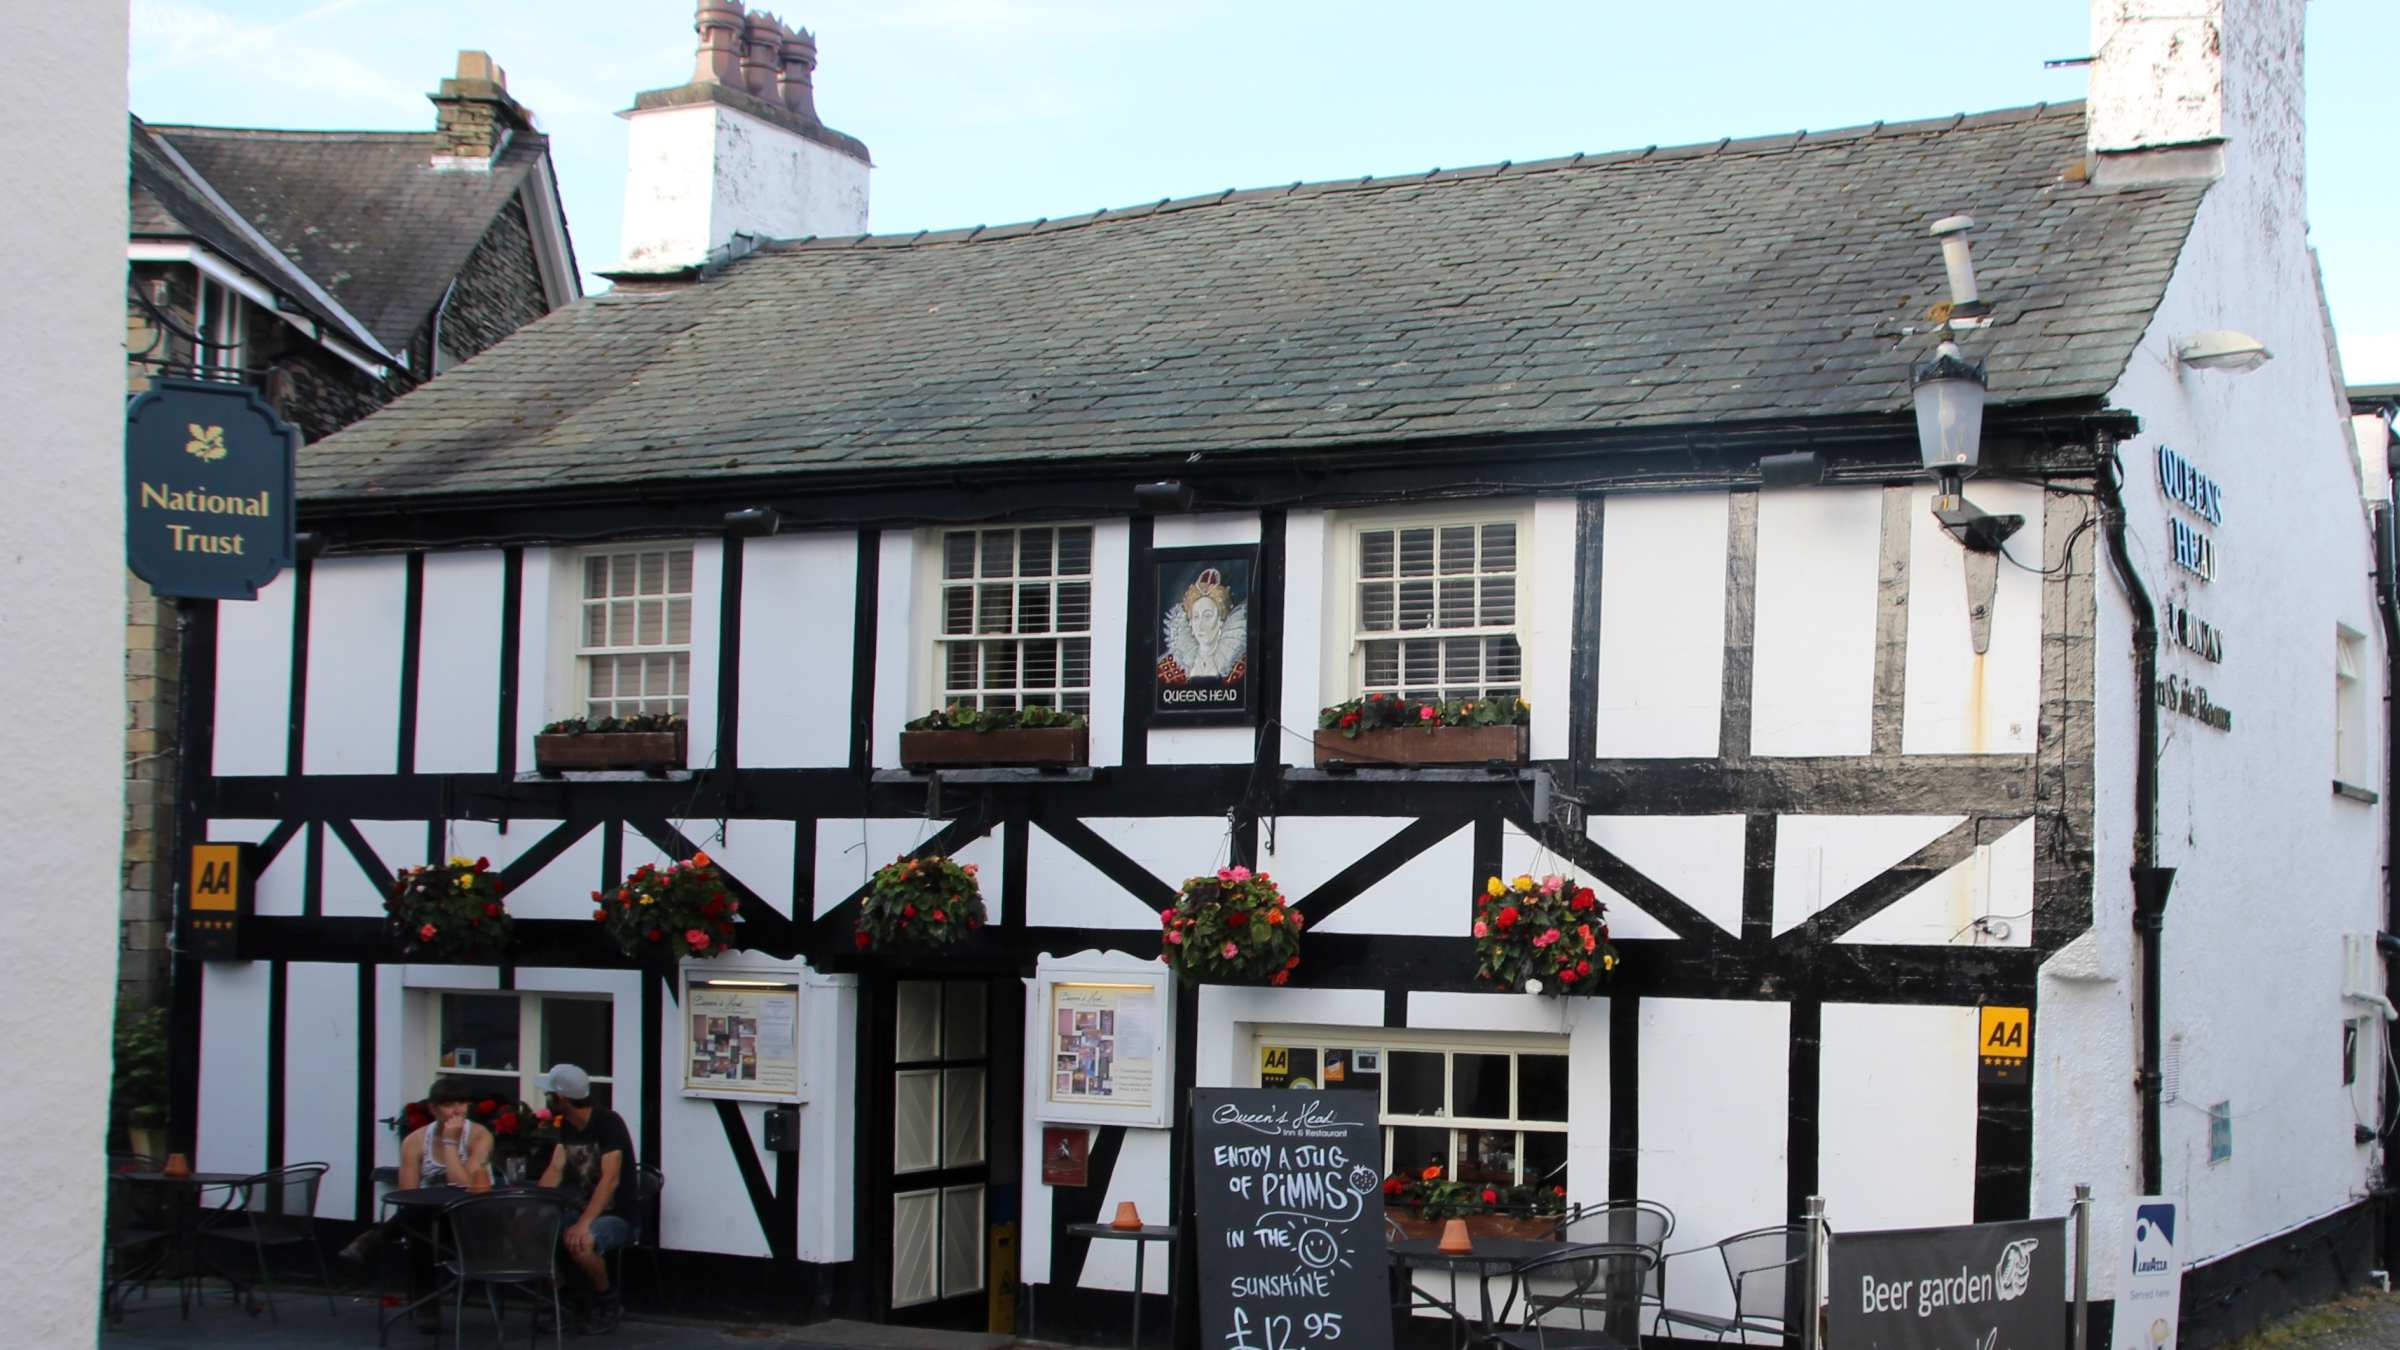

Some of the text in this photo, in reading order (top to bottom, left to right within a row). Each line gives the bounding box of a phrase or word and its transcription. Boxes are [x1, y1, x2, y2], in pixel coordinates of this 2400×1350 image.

[141, 481, 269, 517] National
[2158, 444, 2223, 527] QUEENS
[166, 524, 244, 555] Trust
[2172, 517, 2217, 582] HEAD
[1163, 689, 1237, 704] QUEENS HEAD
[197, 861, 231, 895] AA
[1987, 1021, 2022, 1048] AA
[1264, 1050, 1286, 1069] AA
[1212, 1100, 1364, 1135] Queen's Head
[1283, 1129, 1296, 1137] Inn
[1305, 1129, 1348, 1138] Restaurant
[1213, 1145, 1350, 1171] ENJOY A JUG
[1229, 1176, 1252, 1199] OF
[1253, 1228, 1291, 1248] THE
[1862, 1265, 1992, 1318] Beer garden
